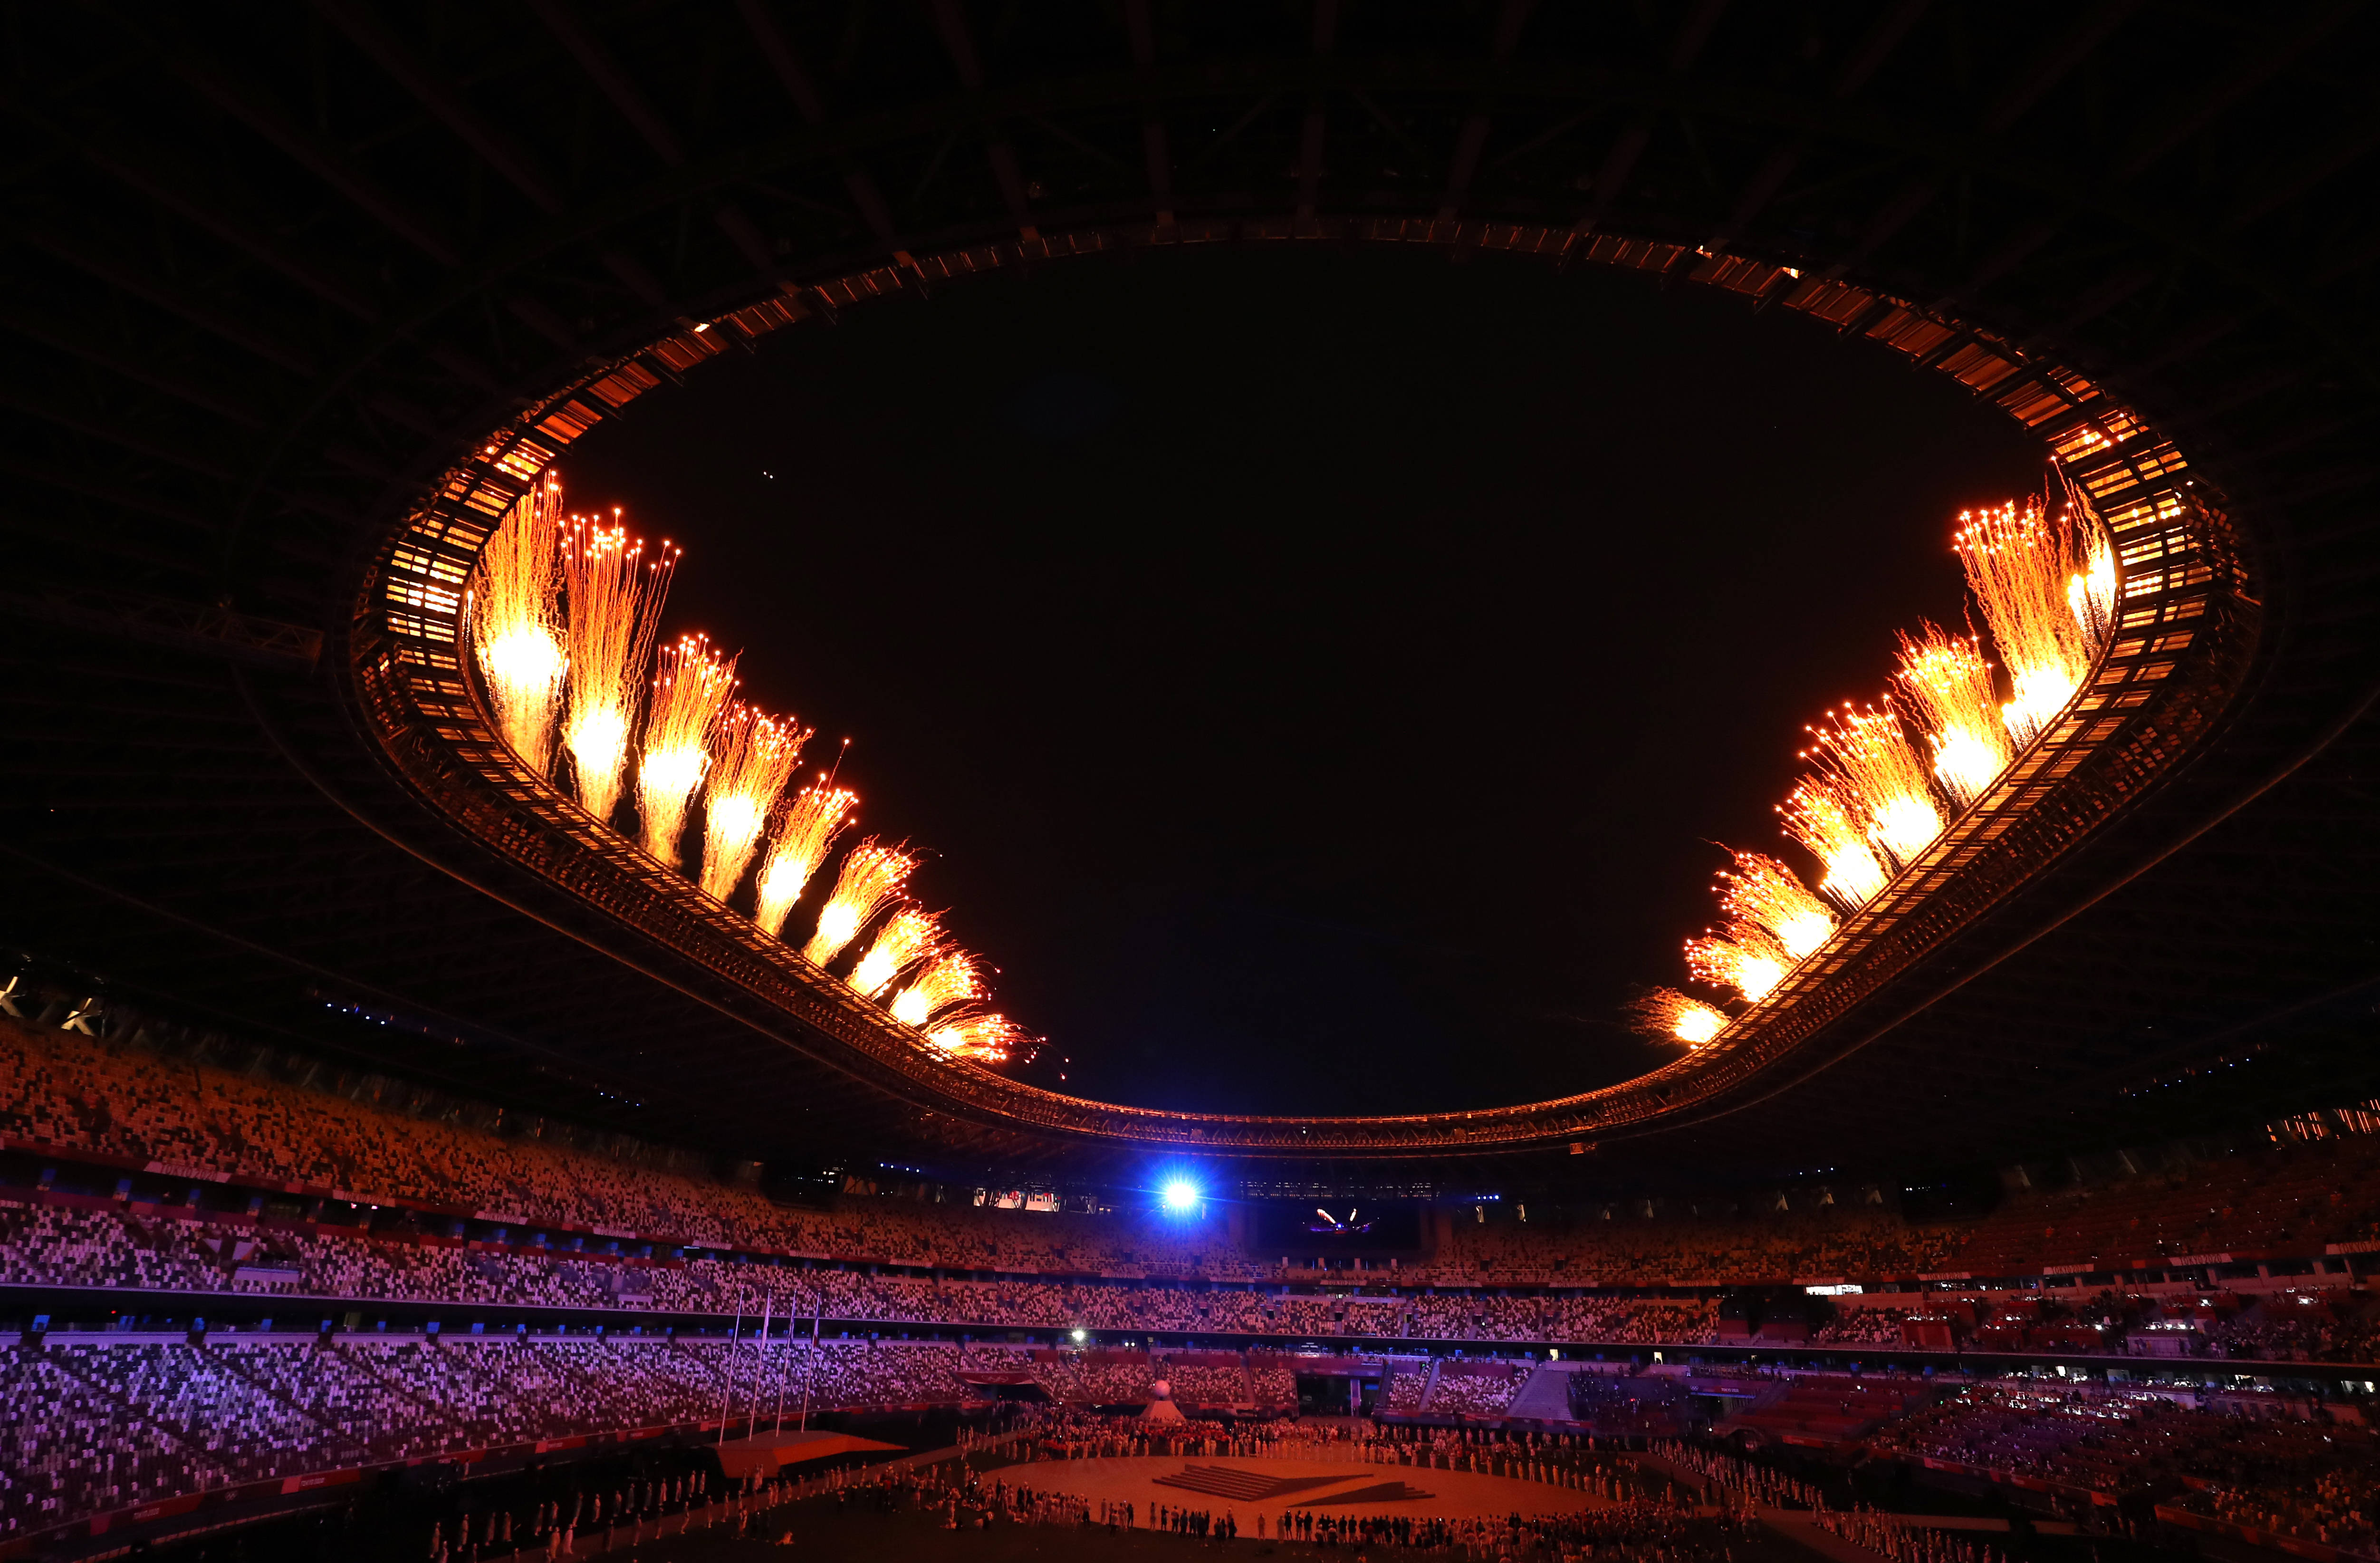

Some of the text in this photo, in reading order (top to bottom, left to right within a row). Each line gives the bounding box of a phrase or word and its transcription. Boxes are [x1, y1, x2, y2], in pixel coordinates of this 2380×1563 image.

[2336, 1242, 2367, 1254] TOKYO
[2179, 1254, 2222, 1265] TOKYO 2020
[2052, 1266, 2071, 1274] TOKYO
